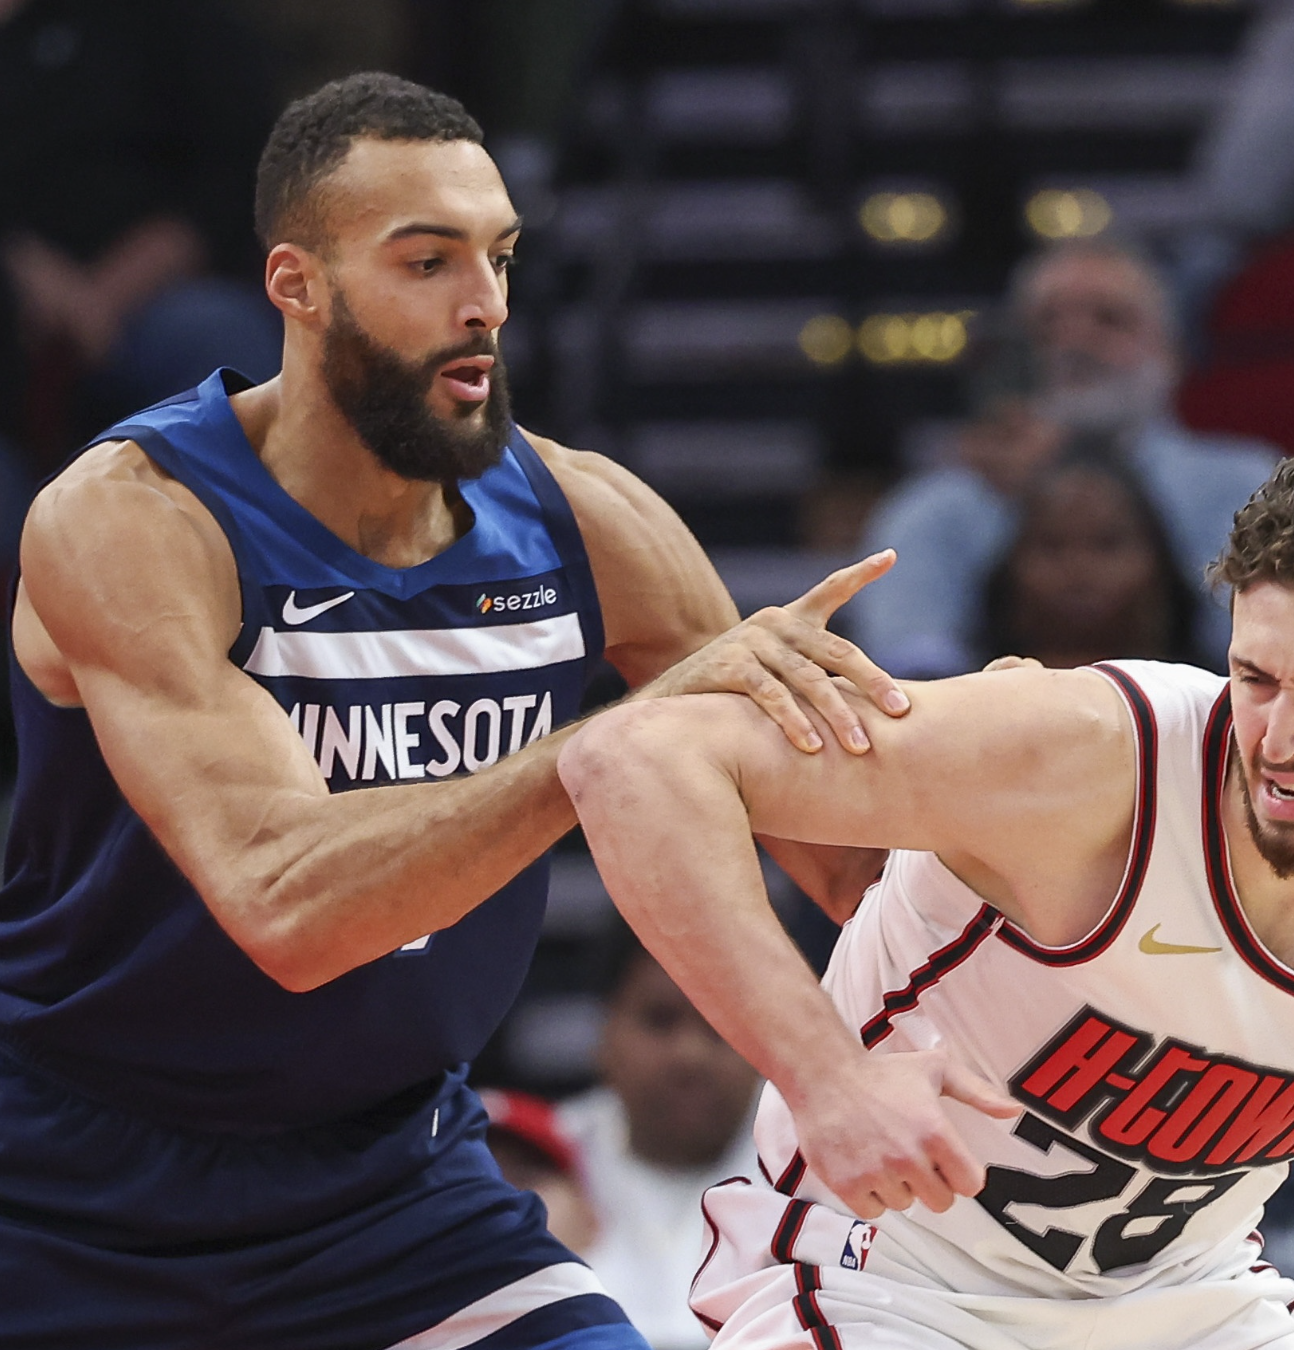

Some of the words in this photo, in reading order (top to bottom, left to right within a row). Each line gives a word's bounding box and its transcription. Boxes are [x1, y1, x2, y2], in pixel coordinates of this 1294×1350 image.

[493, 584, 557, 612] sezzle
[288, 690, 553, 781] INNESOTA
[974, 1111, 1253, 1275] 28
